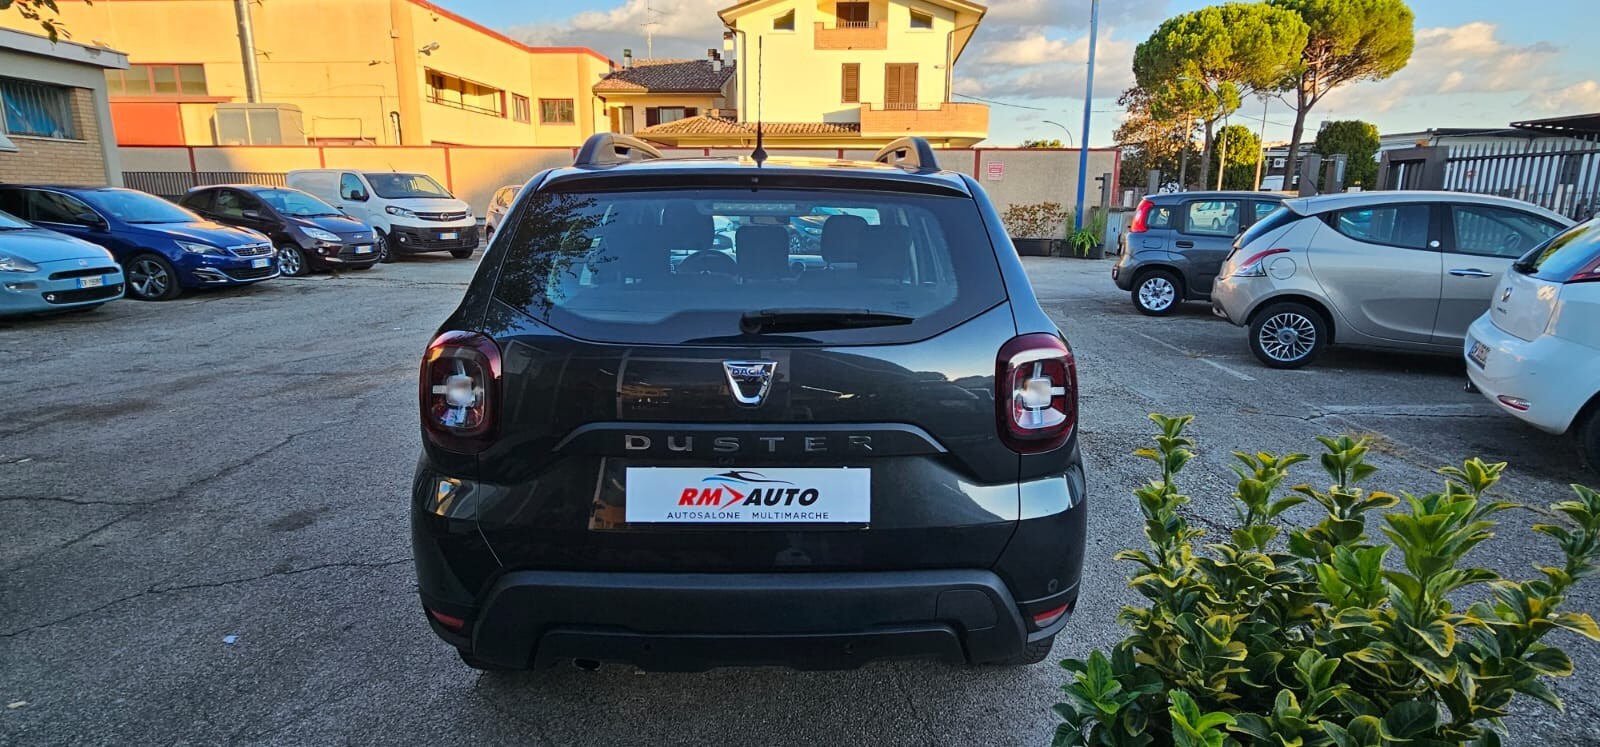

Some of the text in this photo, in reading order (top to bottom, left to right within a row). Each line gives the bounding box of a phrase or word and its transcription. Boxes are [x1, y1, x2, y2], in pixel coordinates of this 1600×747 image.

[732, 367, 767, 376] DACIA
[625, 434, 874, 452] DUSTER
[742, 488, 819, 507] AUTO
[667, 511, 829, 520] AUTOSALONE MULTIMARCHE
